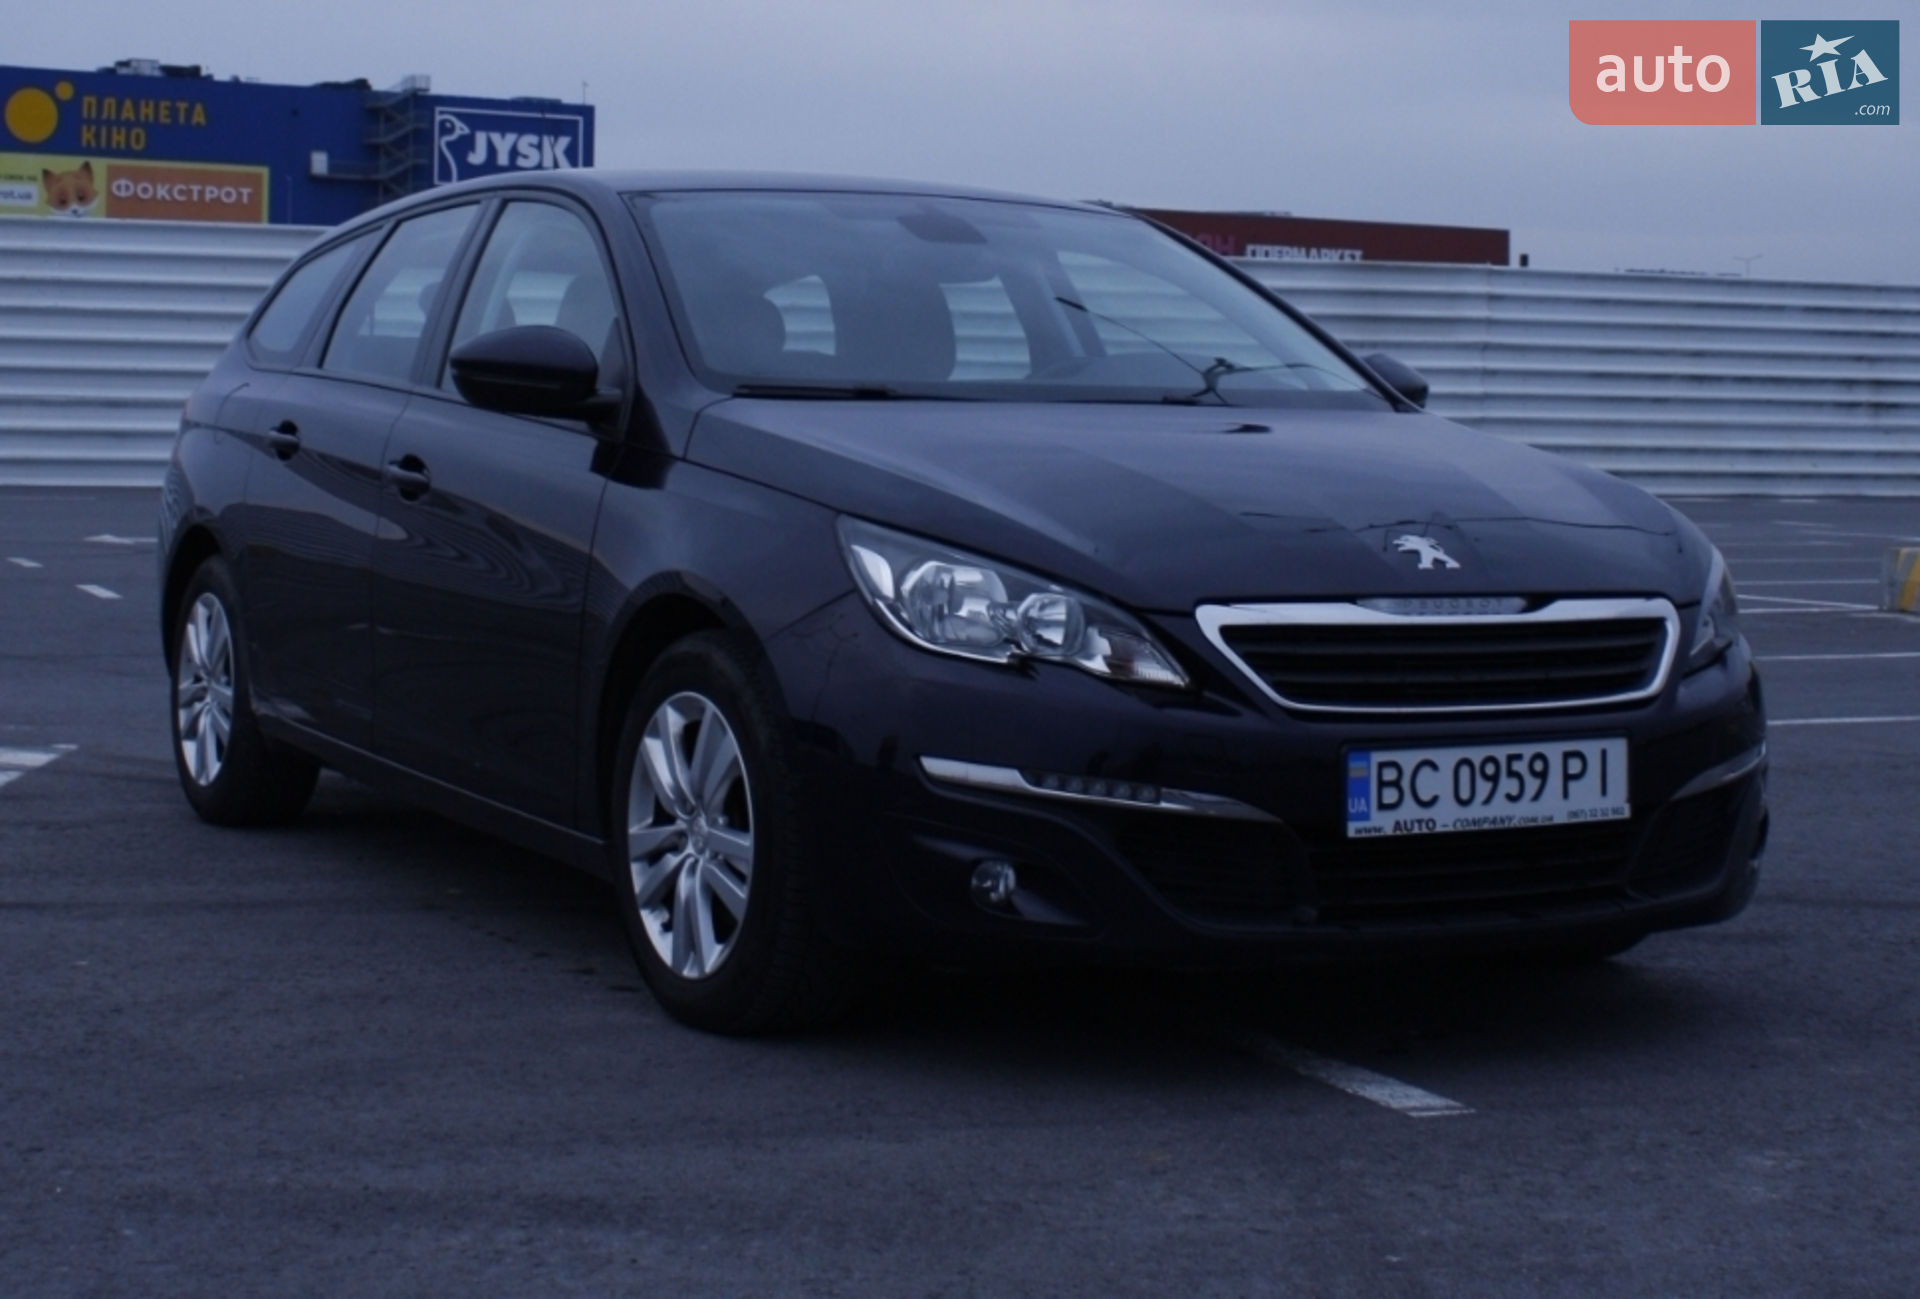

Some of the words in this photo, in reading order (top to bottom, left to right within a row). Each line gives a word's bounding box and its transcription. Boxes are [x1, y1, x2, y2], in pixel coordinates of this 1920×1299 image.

[82, 96, 207, 126] ПЛАНЕТА
[82, 125, 146, 149] КІНО
[466, 130, 572, 170] JYSK
[111, 178, 253, 204] ФОКСТРОТ
[1376, 758, 1440, 812] BC
[1453, 751, 1550, 808] 0959
[1562, 747, 1608, 800] PI
[1348, 796, 1368, 814] UA
[1391, 818, 1437, 834] AUTO
